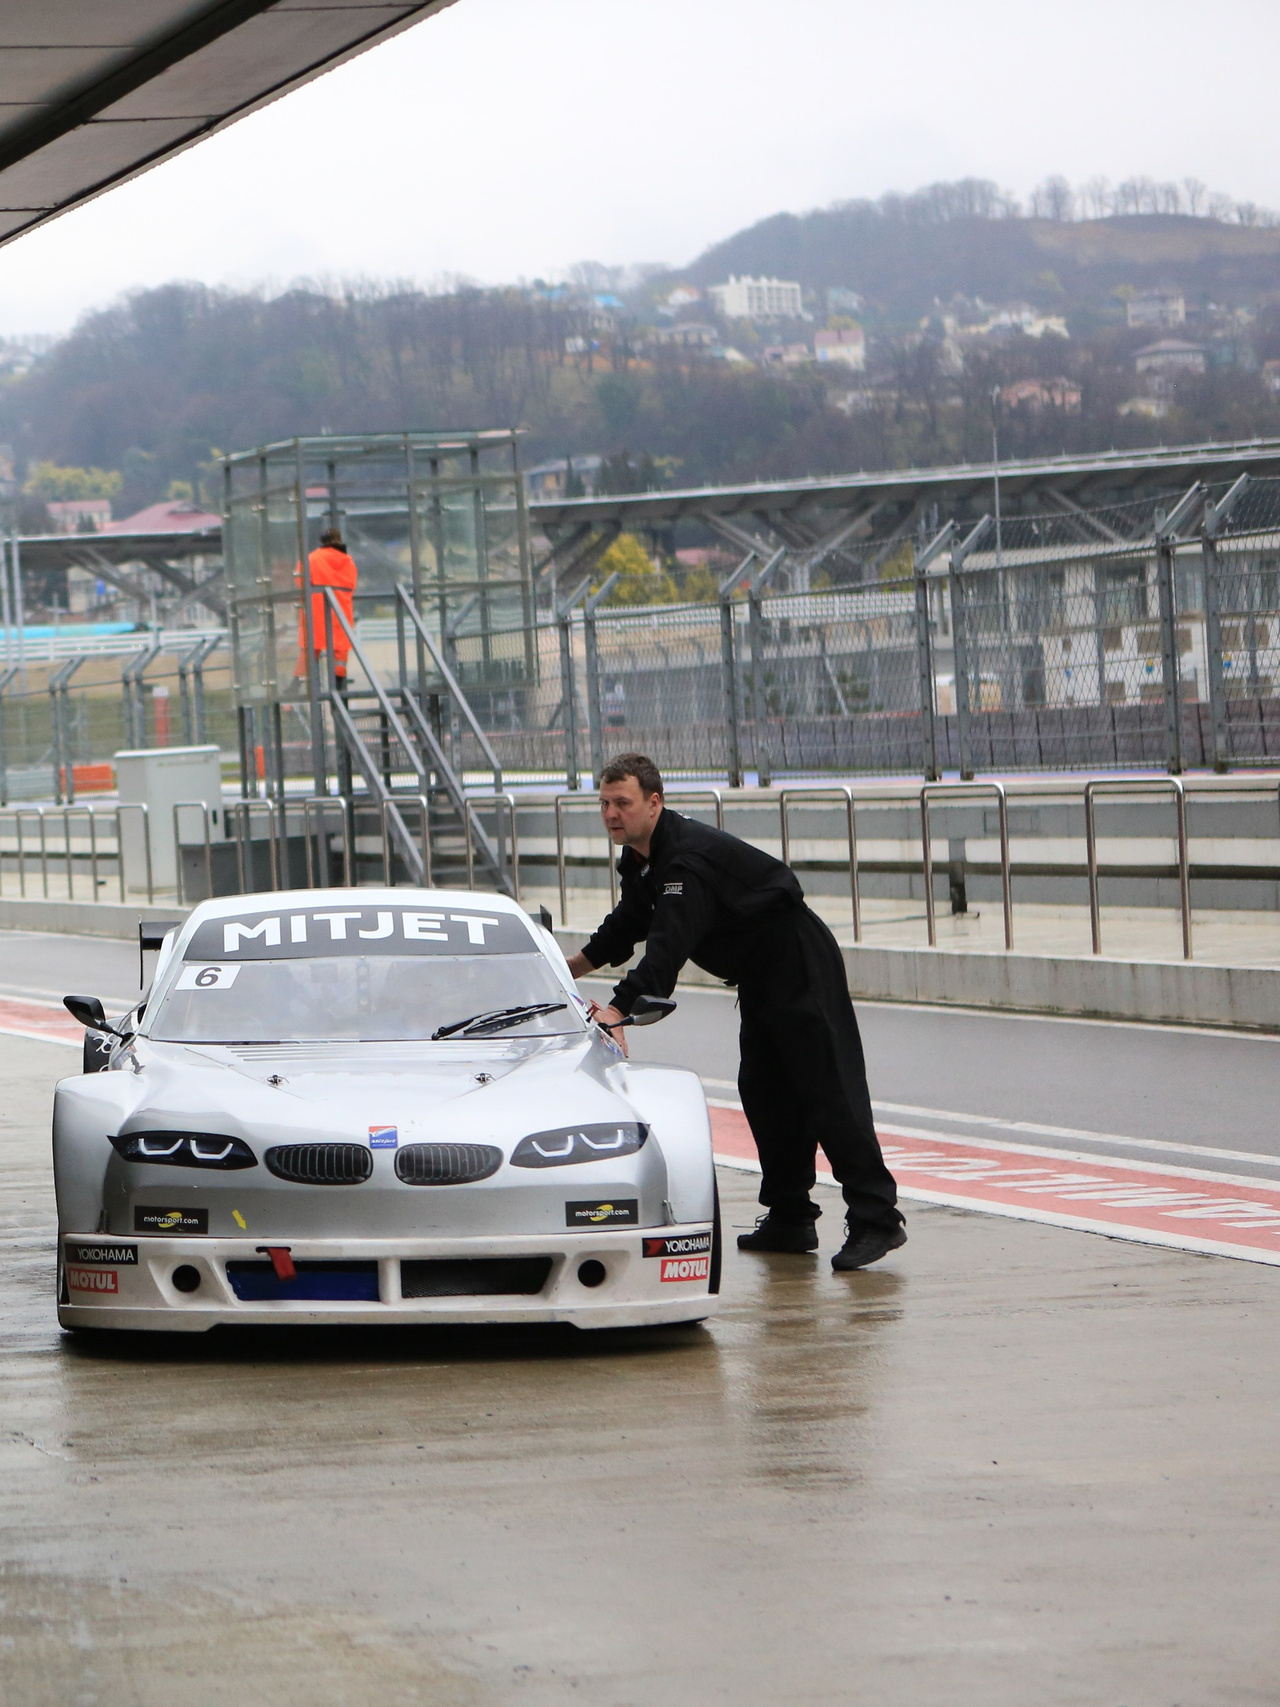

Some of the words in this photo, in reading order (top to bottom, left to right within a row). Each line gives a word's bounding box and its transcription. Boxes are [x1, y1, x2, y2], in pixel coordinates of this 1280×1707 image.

[664, 884, 683, 894] OMP
[223, 911, 499, 952] MITJET
[194, 966, 222, 987] 6
[143, 1216, 199, 1225] motorsport.com
[575, 1209, 630, 1218] motorsport.com
[665, 1237, 710, 1253] YOKOHAMA
[77, 1248, 135, 1261] YOKOHAMA
[664, 1259, 708, 1279] MOTUL
[70, 1270, 115, 1290] MOTUL
